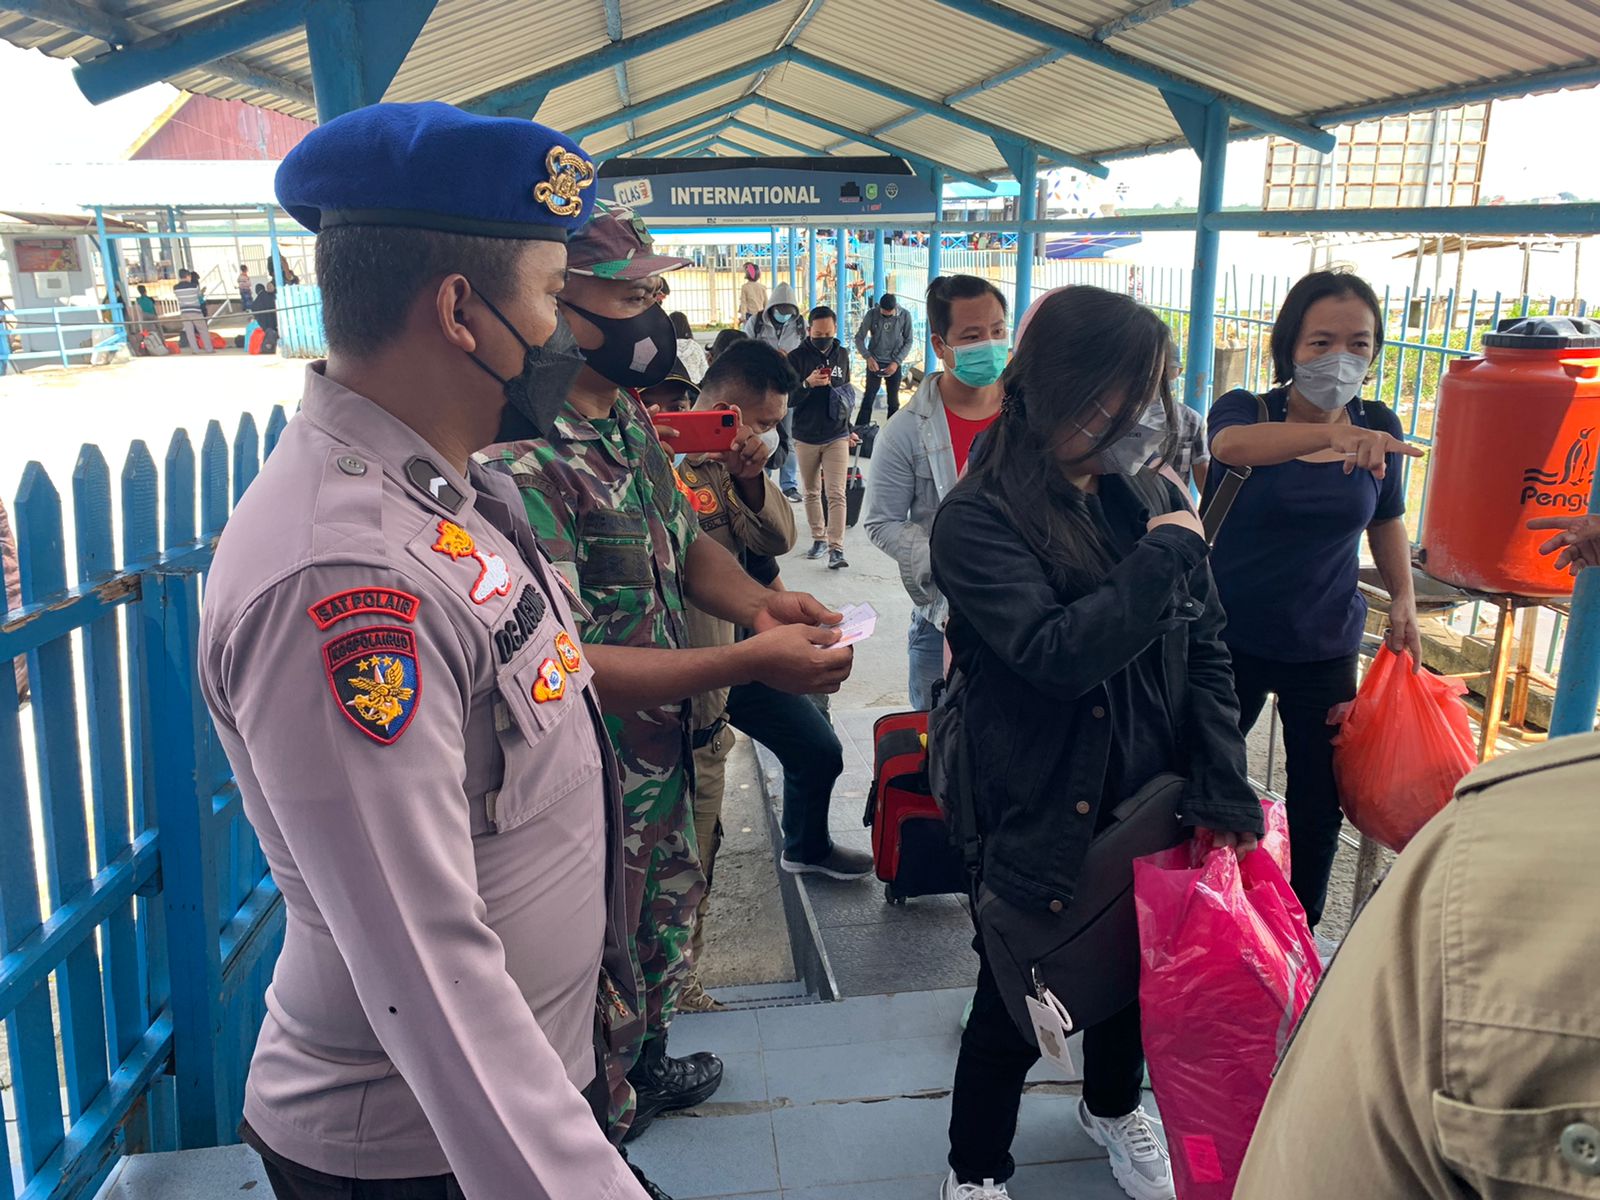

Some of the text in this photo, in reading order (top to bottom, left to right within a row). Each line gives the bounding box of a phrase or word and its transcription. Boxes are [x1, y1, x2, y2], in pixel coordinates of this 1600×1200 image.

[670, 185, 821, 206] INTERNATIONAL
[316, 591, 412, 621] SAT POLAIR
